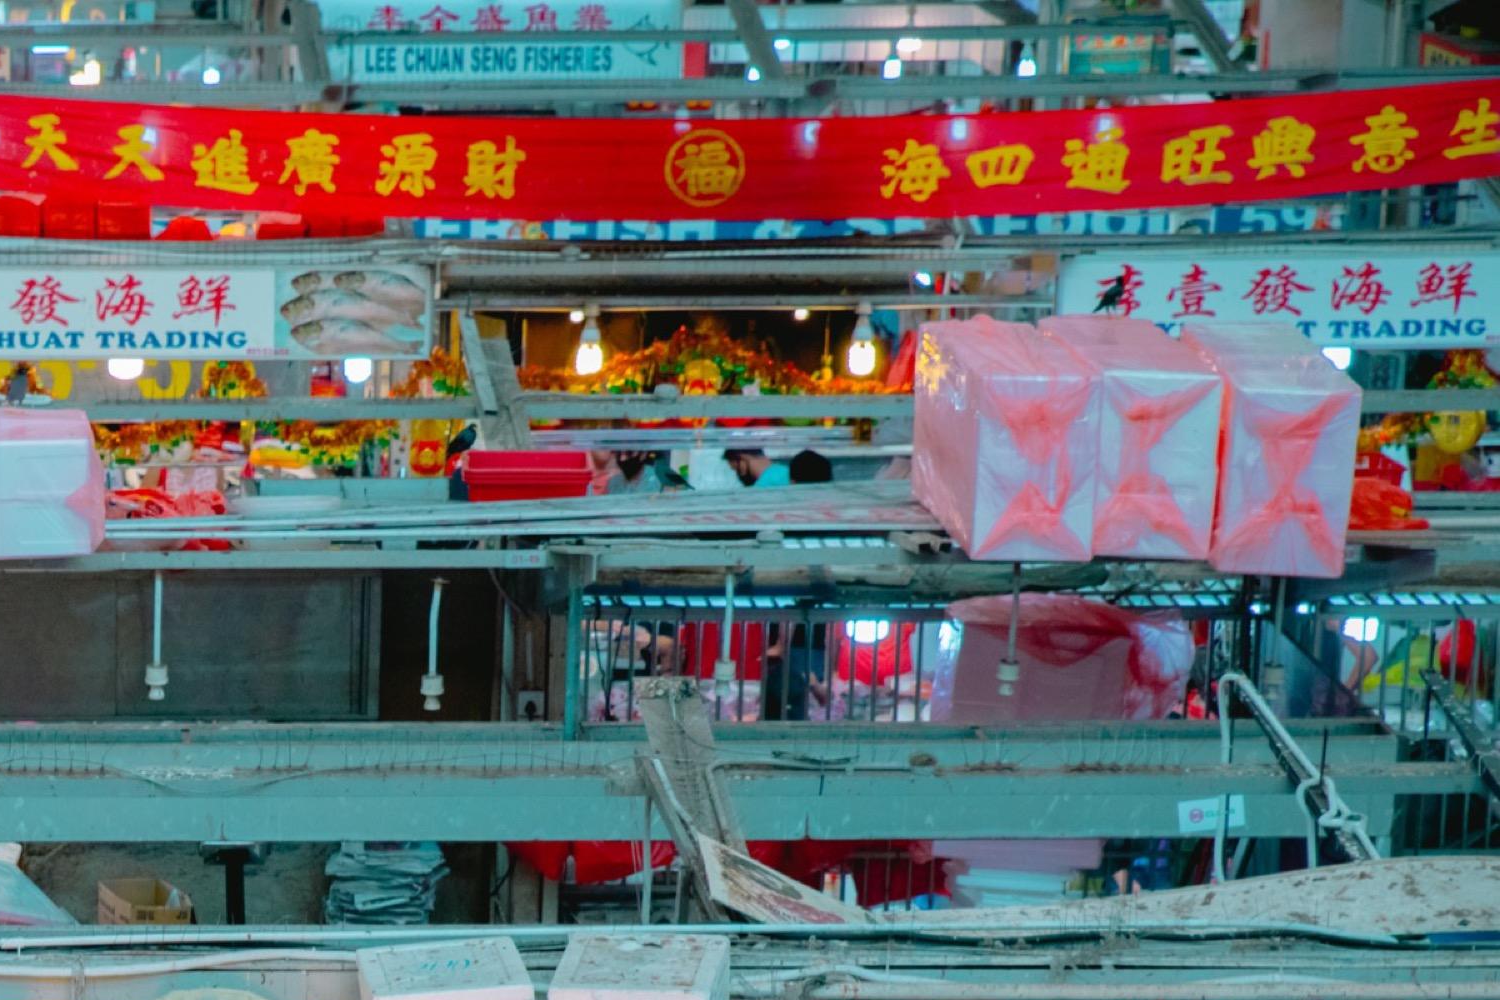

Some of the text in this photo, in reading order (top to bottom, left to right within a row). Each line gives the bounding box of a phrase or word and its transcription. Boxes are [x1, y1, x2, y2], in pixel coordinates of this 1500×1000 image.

[365, 45, 612, 72] LEE CHUAN SENG FISHERIES
[676, 140, 736, 197] 福
[1328, 318, 1487, 338] TRADING
[96, 330, 249, 350] TRADING
